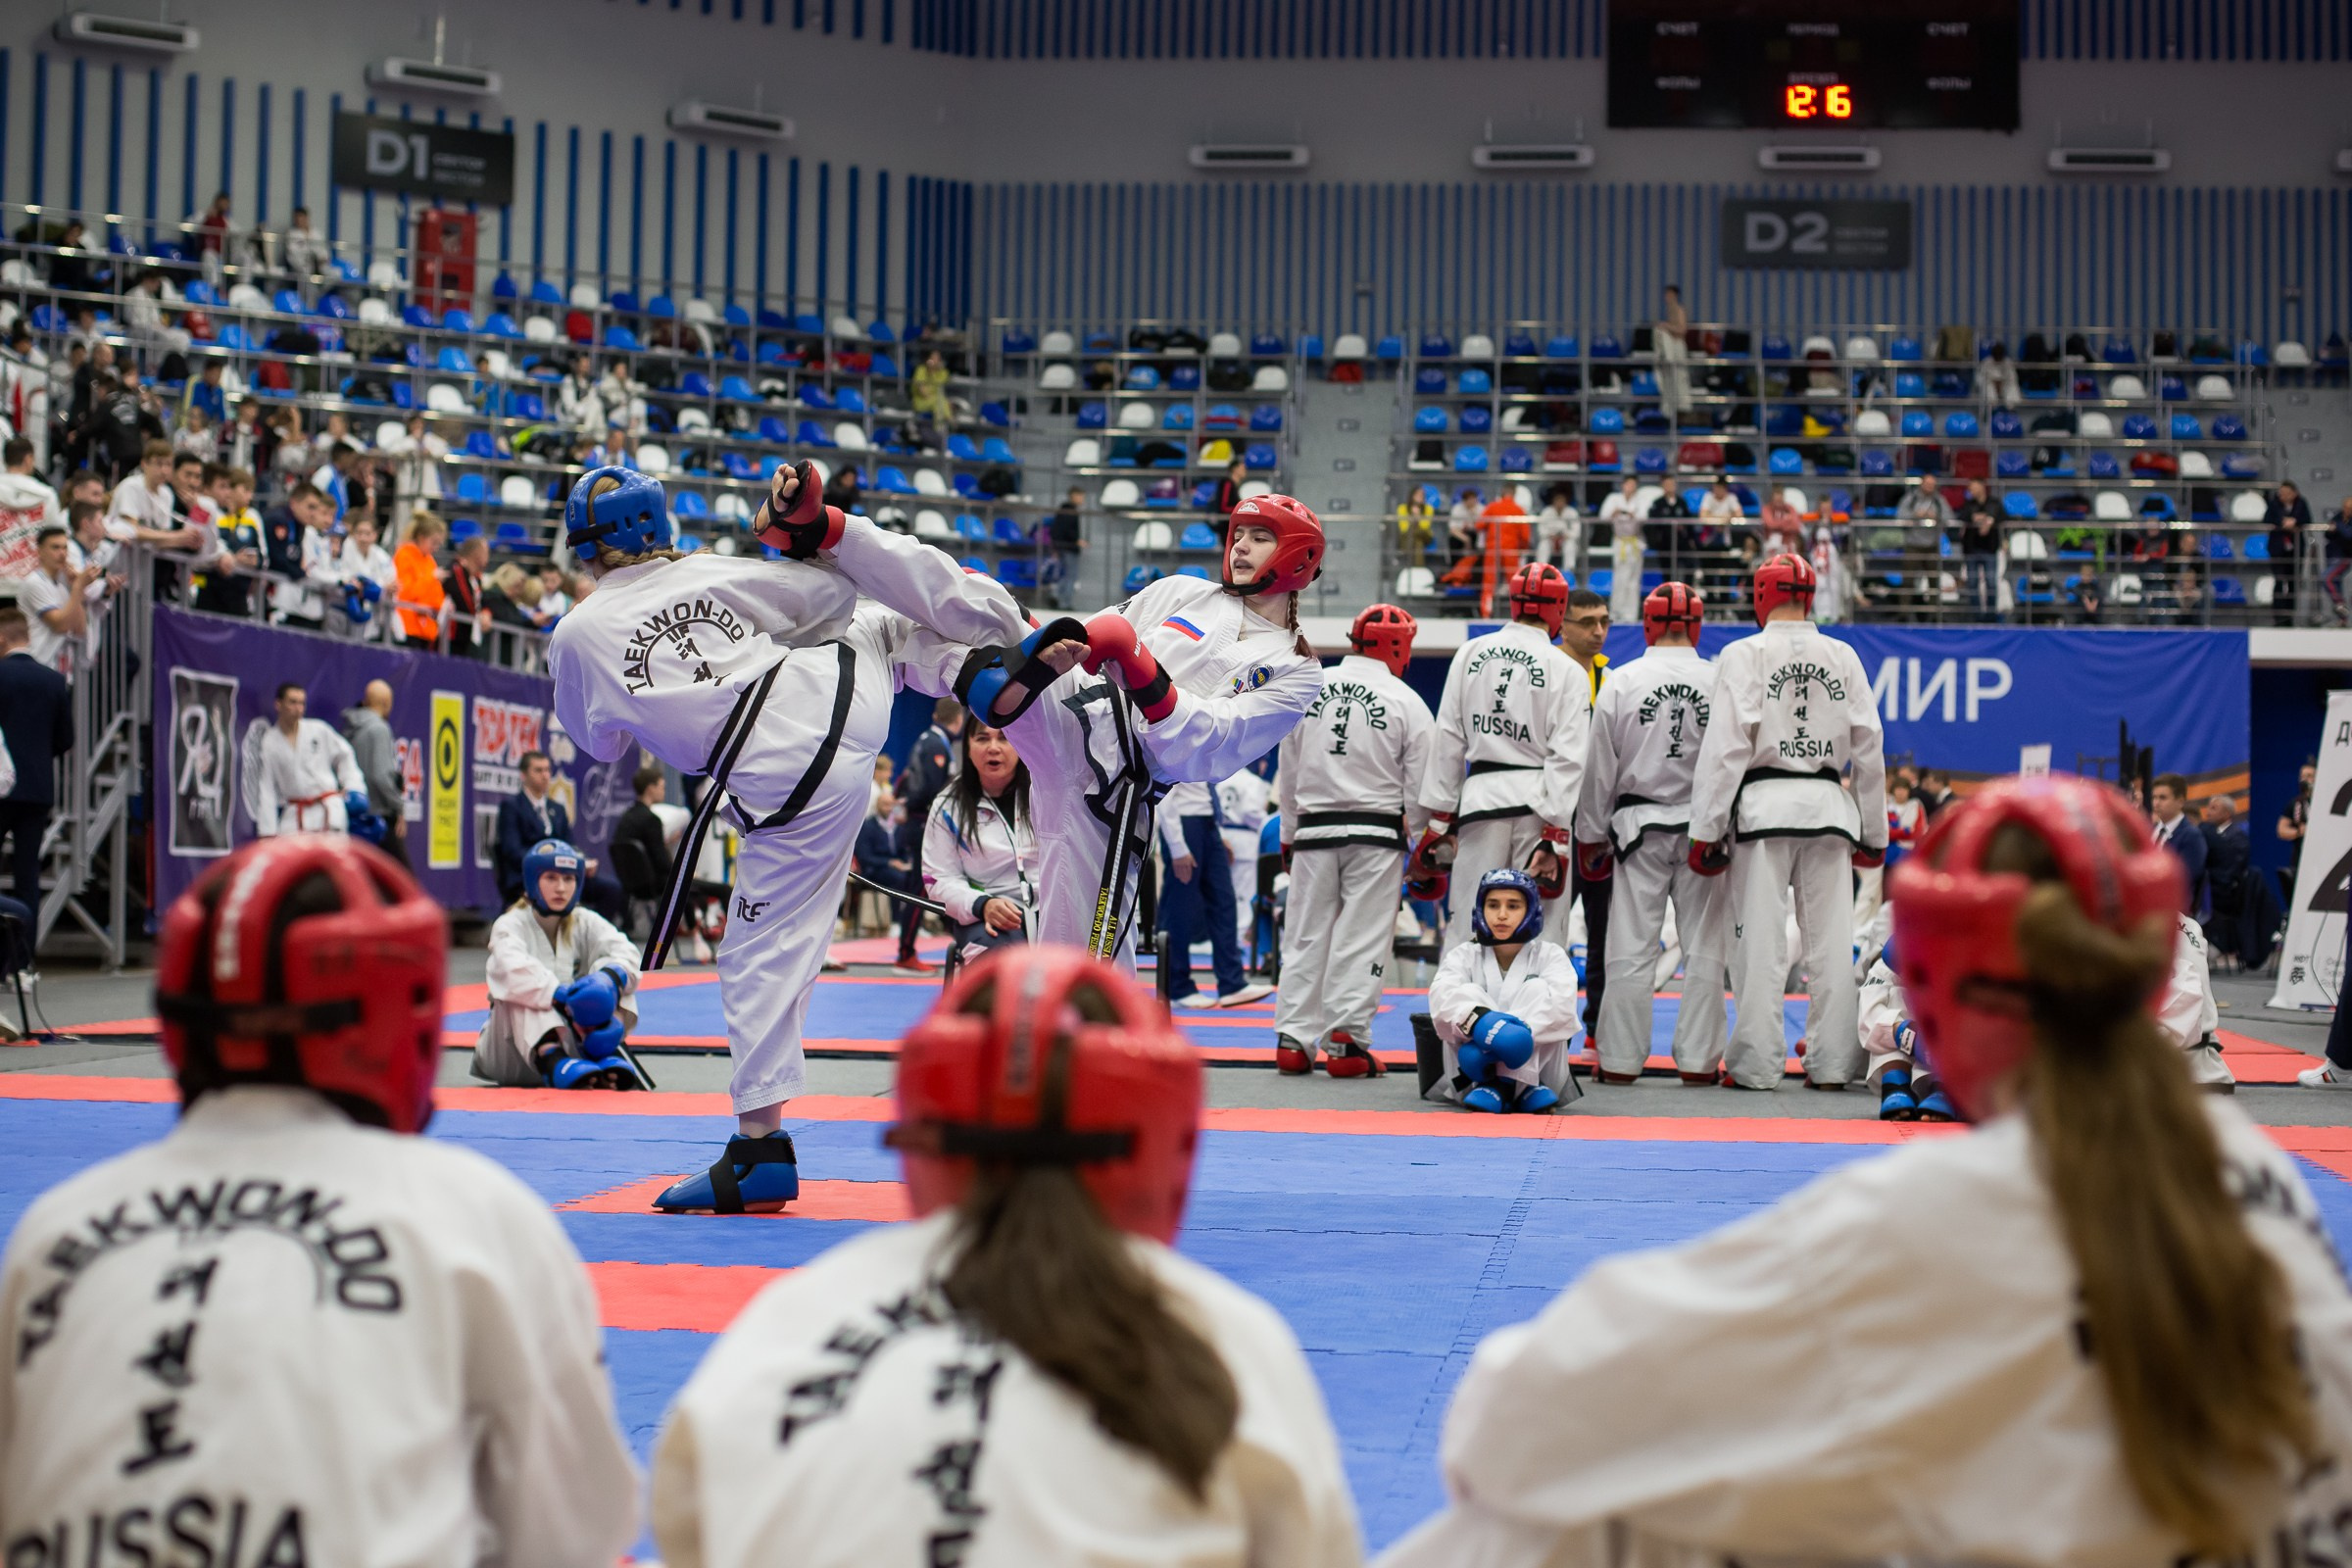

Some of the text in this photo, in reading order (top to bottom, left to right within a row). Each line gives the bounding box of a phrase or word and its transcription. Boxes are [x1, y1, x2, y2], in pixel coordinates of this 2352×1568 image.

[367, 128, 429, 180] D1
[1745, 211, 1829, 253] D2
[623, 599, 745, 695] TAEKWON-DO
[1467, 647, 1545, 688] TAEKWON-DO
[1766, 662, 1845, 702] TAEKWON-DO
[1304, 682, 1388, 731] TAEKWON-DO
[1472, 713, 1531, 743] RUSSIA
[1639, 683, 1710, 728] TAEKWON-DO
[1779, 740, 1835, 759] RUSSIA
[1093, 887, 1110, 932] TAEKWON-DO
[18, 1180, 404, 1366] TAEKWON-DO
